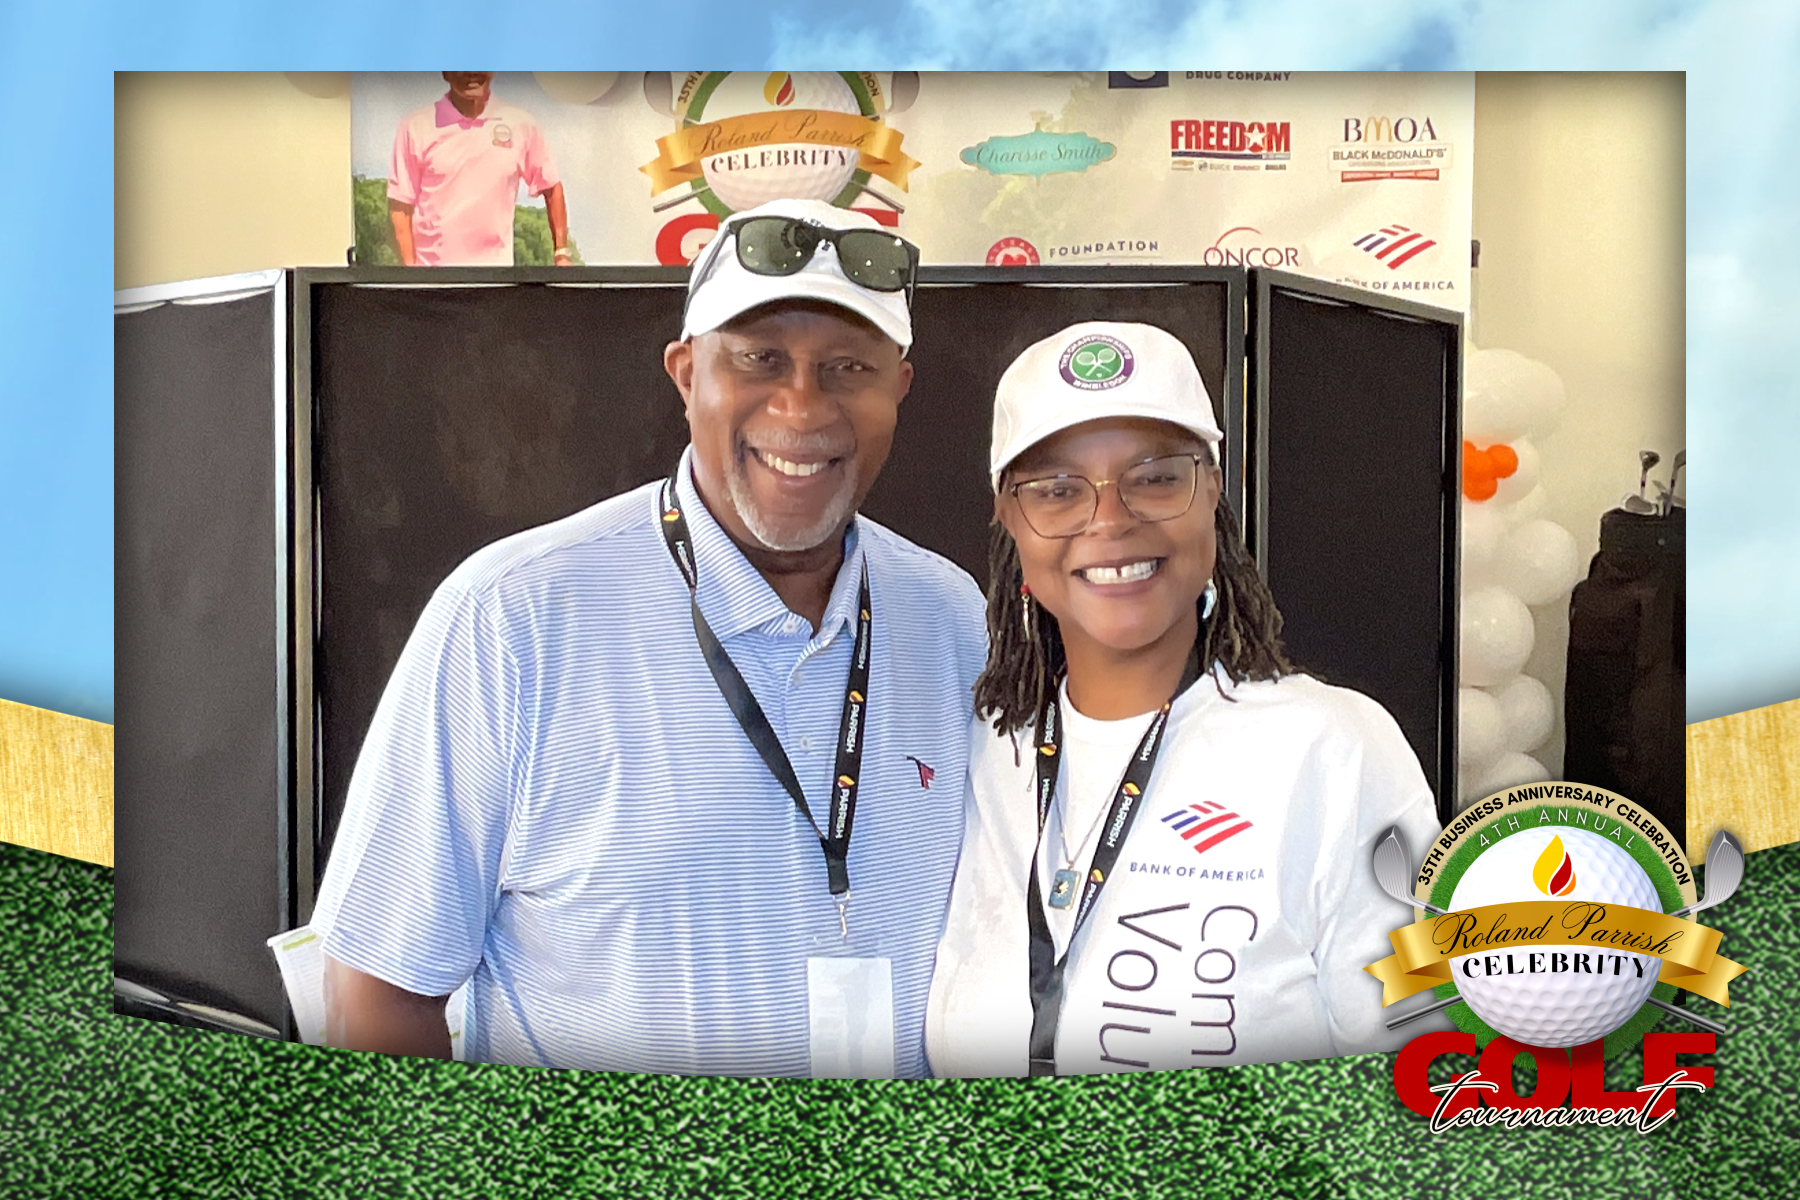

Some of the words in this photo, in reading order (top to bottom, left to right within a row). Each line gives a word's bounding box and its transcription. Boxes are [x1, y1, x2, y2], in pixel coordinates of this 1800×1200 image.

[1186, 71, 1222, 80] DRUG
[1227, 71, 1292, 82] COMPANY
[689, 122, 778, 154] Roland
[784, 112, 877, 147] Parrish
[1171, 119, 1290, 153] FREEDOM
[1342, 115, 1439, 142] BMOA
[711, 149, 847, 173] CELEBRITY
[976, 146, 1048, 163] Charisse
[1050, 143, 1101, 161] Smith
[1333, 150, 1369, 161] BLACK
[1050, 240, 1159, 258] FOUNDATION
[1204, 247, 1300, 267] ONCOR
[1372, 281, 1389, 290] OF
[1392, 280, 1455, 291] AMERICA
[846, 704, 860, 754] PARRISH
[834, 787, 851, 840] PARRISH
[1106, 795, 1133, 848] PARRISH
[1130, 861, 1171, 878] BANK
[1176, 866, 1197, 879] OF
[1199, 868, 1265, 882] AMERICA
[1191, 904, 1259, 1069] Com
